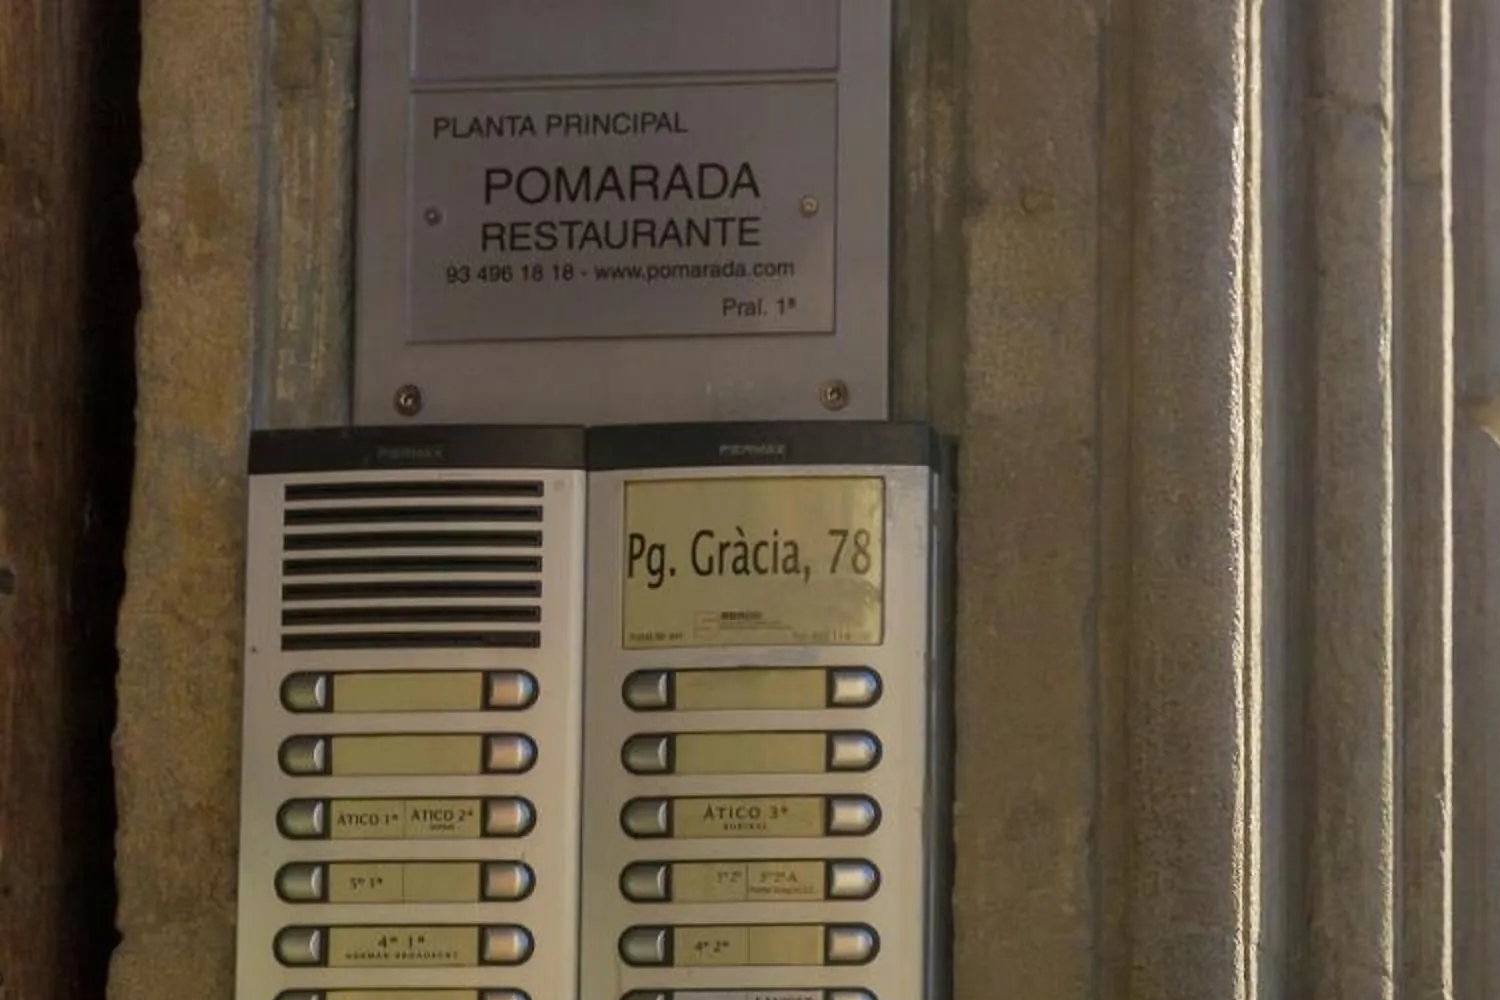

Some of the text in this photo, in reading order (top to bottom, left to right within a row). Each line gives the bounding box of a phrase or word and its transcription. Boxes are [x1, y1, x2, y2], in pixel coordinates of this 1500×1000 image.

[433, 112, 689, 139] PLANTA PRINCIPAL
[484, 162, 761, 204] POMARADA
[481, 217, 761, 252] RESTAURANTE
[446, 265, 470, 284] 93
[477, 264, 512, 283] 496
[522, 264, 545, 282] 18
[553, 263, 575, 281] 18
[593, 259, 796, 283] www.pomarada.com
[722, 297, 768, 318] Pral.
[626, 528, 873, 588] Pg. Gràcia, 78
